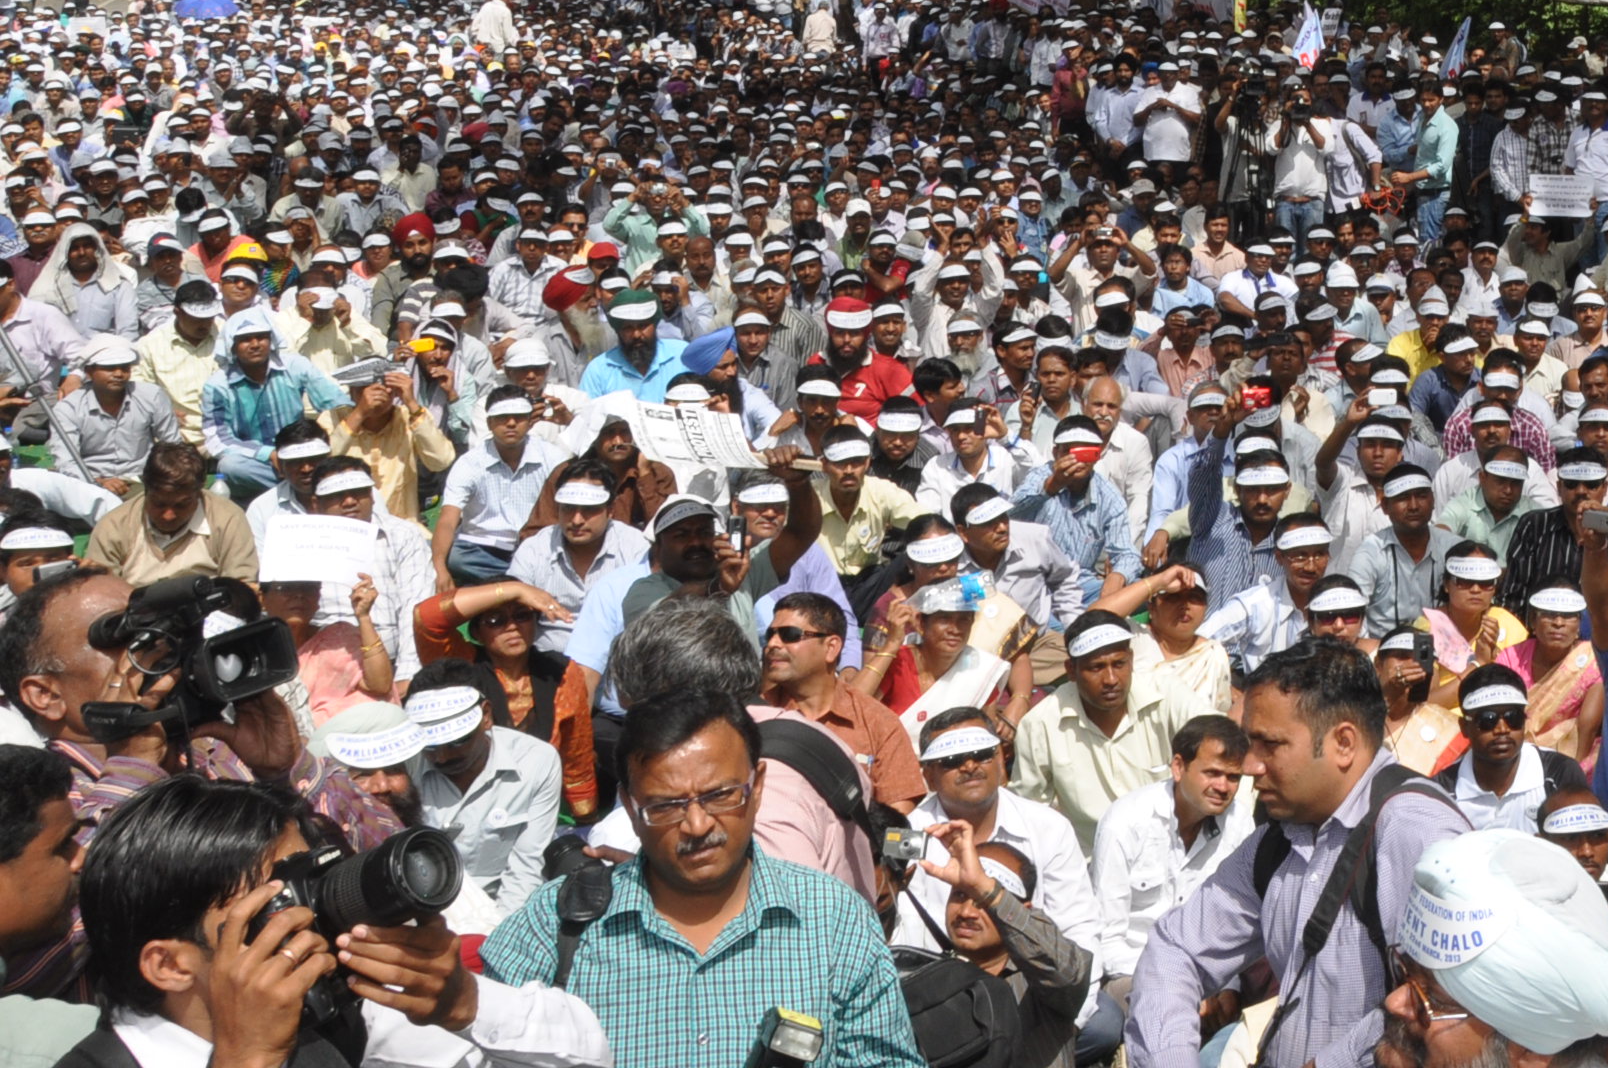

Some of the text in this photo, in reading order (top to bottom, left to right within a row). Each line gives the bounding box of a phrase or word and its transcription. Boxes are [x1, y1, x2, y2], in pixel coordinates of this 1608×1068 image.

[340, 739, 406, 756] PARLIAMENT
[1419, 894, 1453, 921] FEDERATION
[1456, 911, 1465, 922] OF
[1469, 908, 1495, 922] INDIA
[1431, 929, 1483, 951] CHALO
[1444, 953, 1461, 963] 2013
